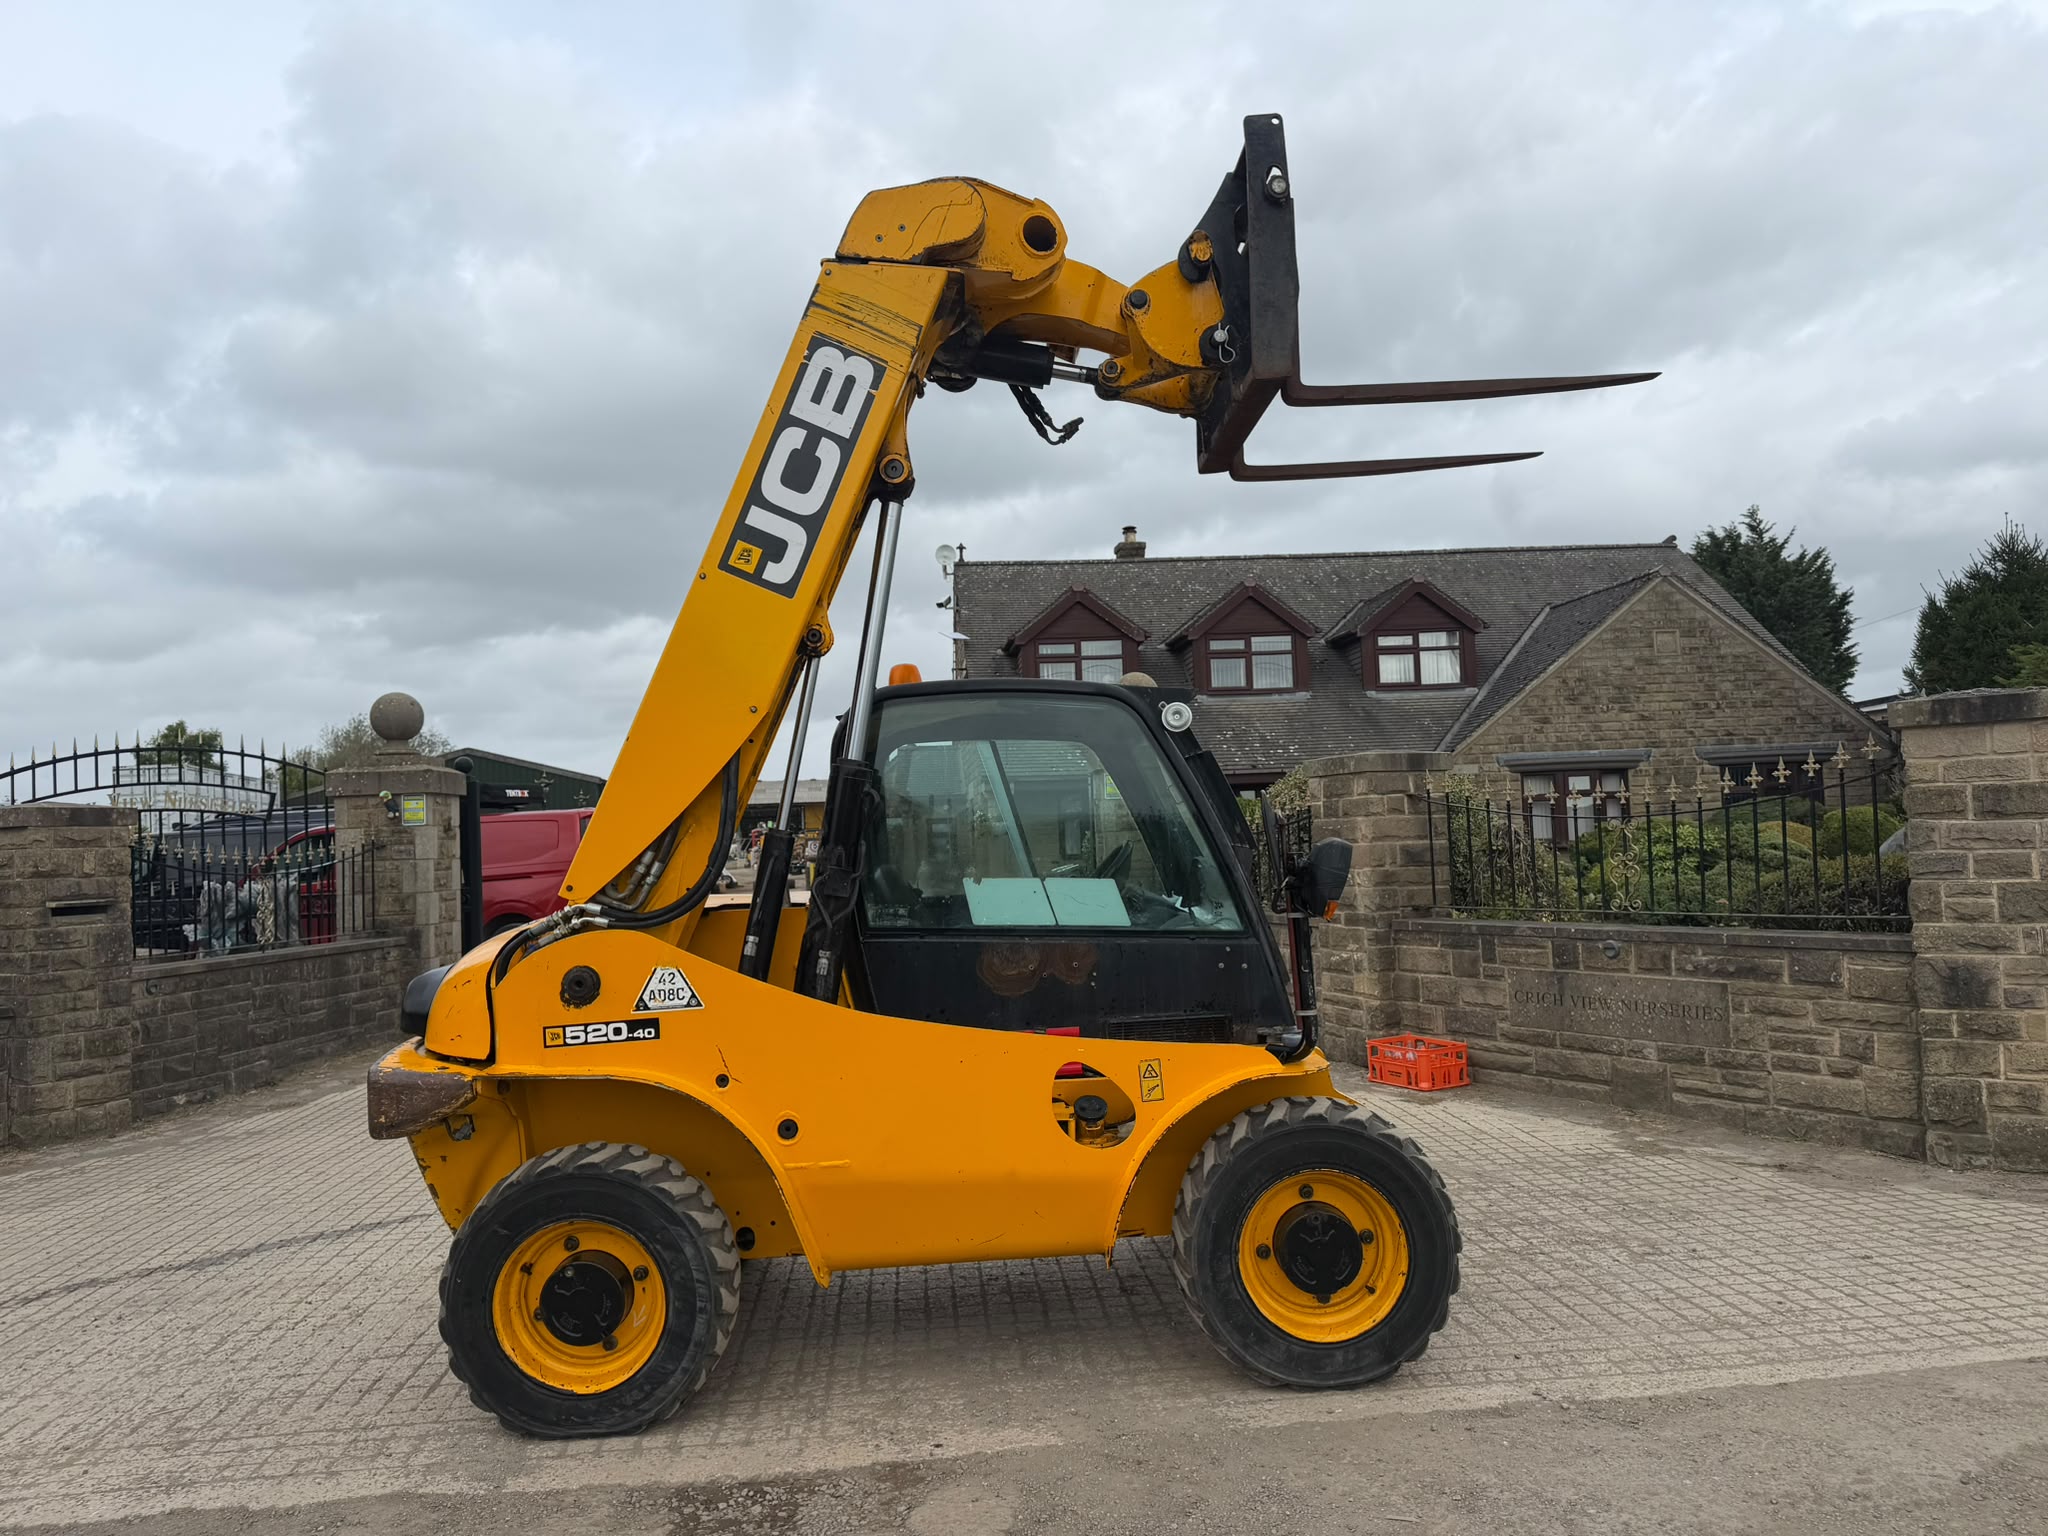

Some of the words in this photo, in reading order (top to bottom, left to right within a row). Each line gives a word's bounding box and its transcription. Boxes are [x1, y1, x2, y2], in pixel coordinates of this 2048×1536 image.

[744, 346, 875, 585] JCB
[658, 972, 676, 986] 42
[1514, 990, 1563, 1008] CRICH
[1570, 994, 1613, 1011] VIEW
[1619, 999, 1725, 1022] NURSERIES
